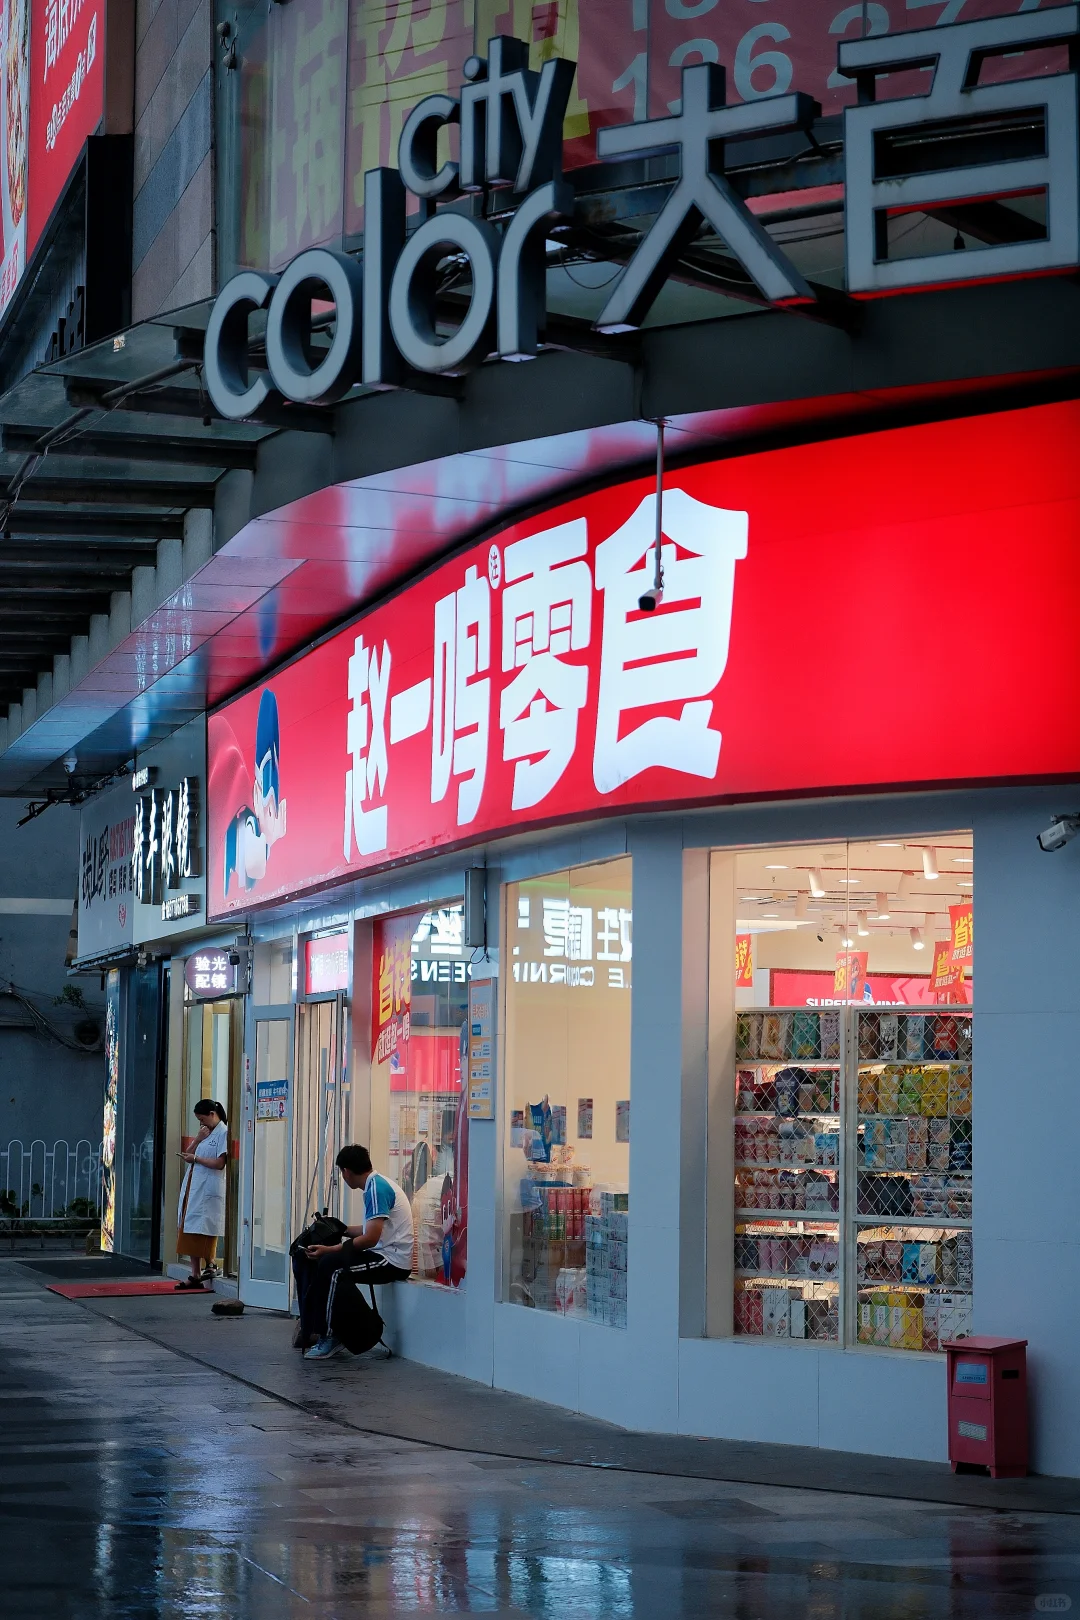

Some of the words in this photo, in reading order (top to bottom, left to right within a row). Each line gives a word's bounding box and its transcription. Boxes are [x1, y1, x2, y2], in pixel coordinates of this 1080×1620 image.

[399, 35, 576, 199] city
[204, 166, 561, 420] color
[343, 487, 749, 864] 赵一鸣零食
[195, 955, 227, 972] 验光
[195, 973, 227, 990] 配镜
